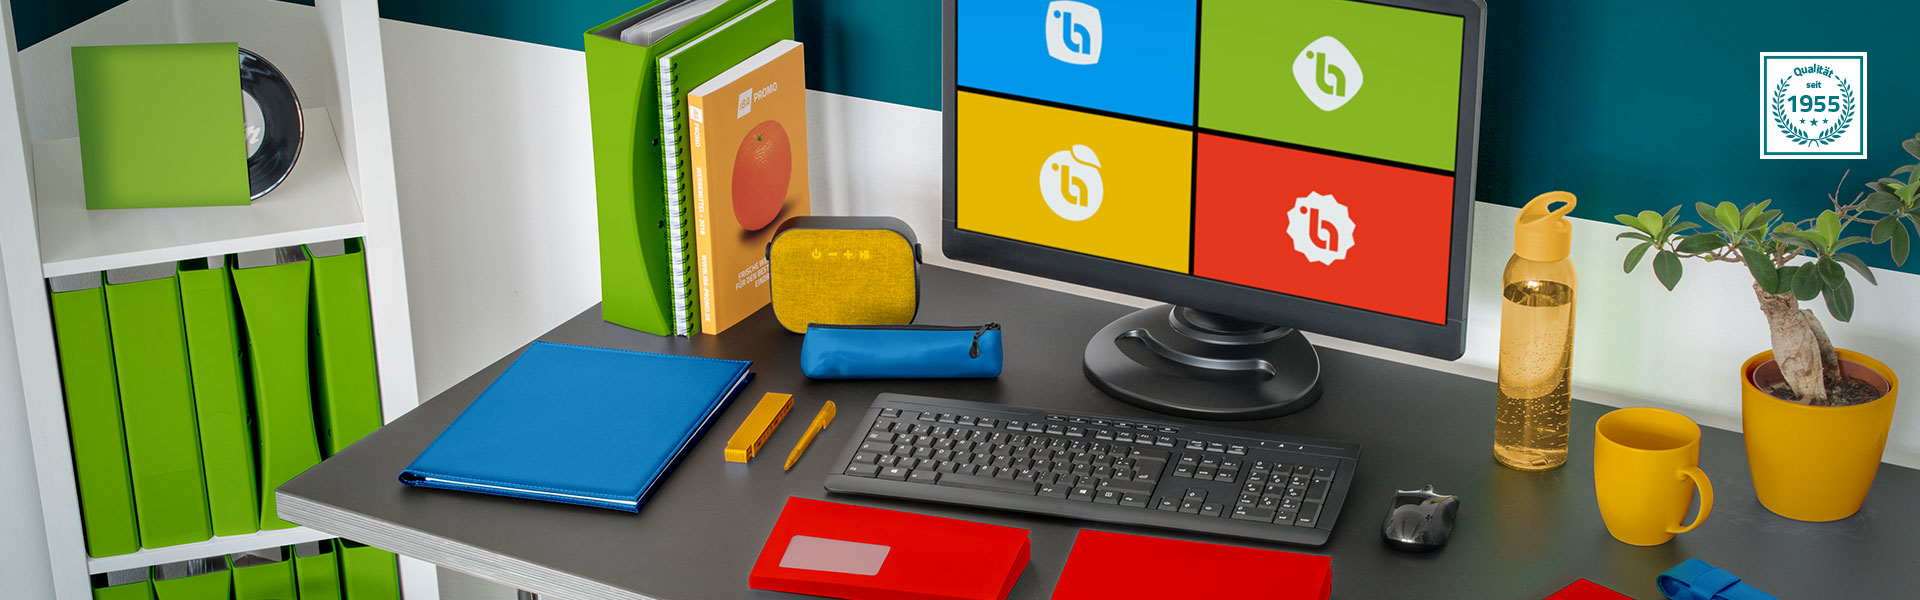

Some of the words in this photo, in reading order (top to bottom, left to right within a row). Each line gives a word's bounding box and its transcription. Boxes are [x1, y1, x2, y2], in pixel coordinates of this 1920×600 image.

[753, 81, 778, 102] PROMO
[738, 261, 759, 281] FRISCHE
[735, 279, 746, 291] FÜR
[746, 272, 757, 284] DEN
